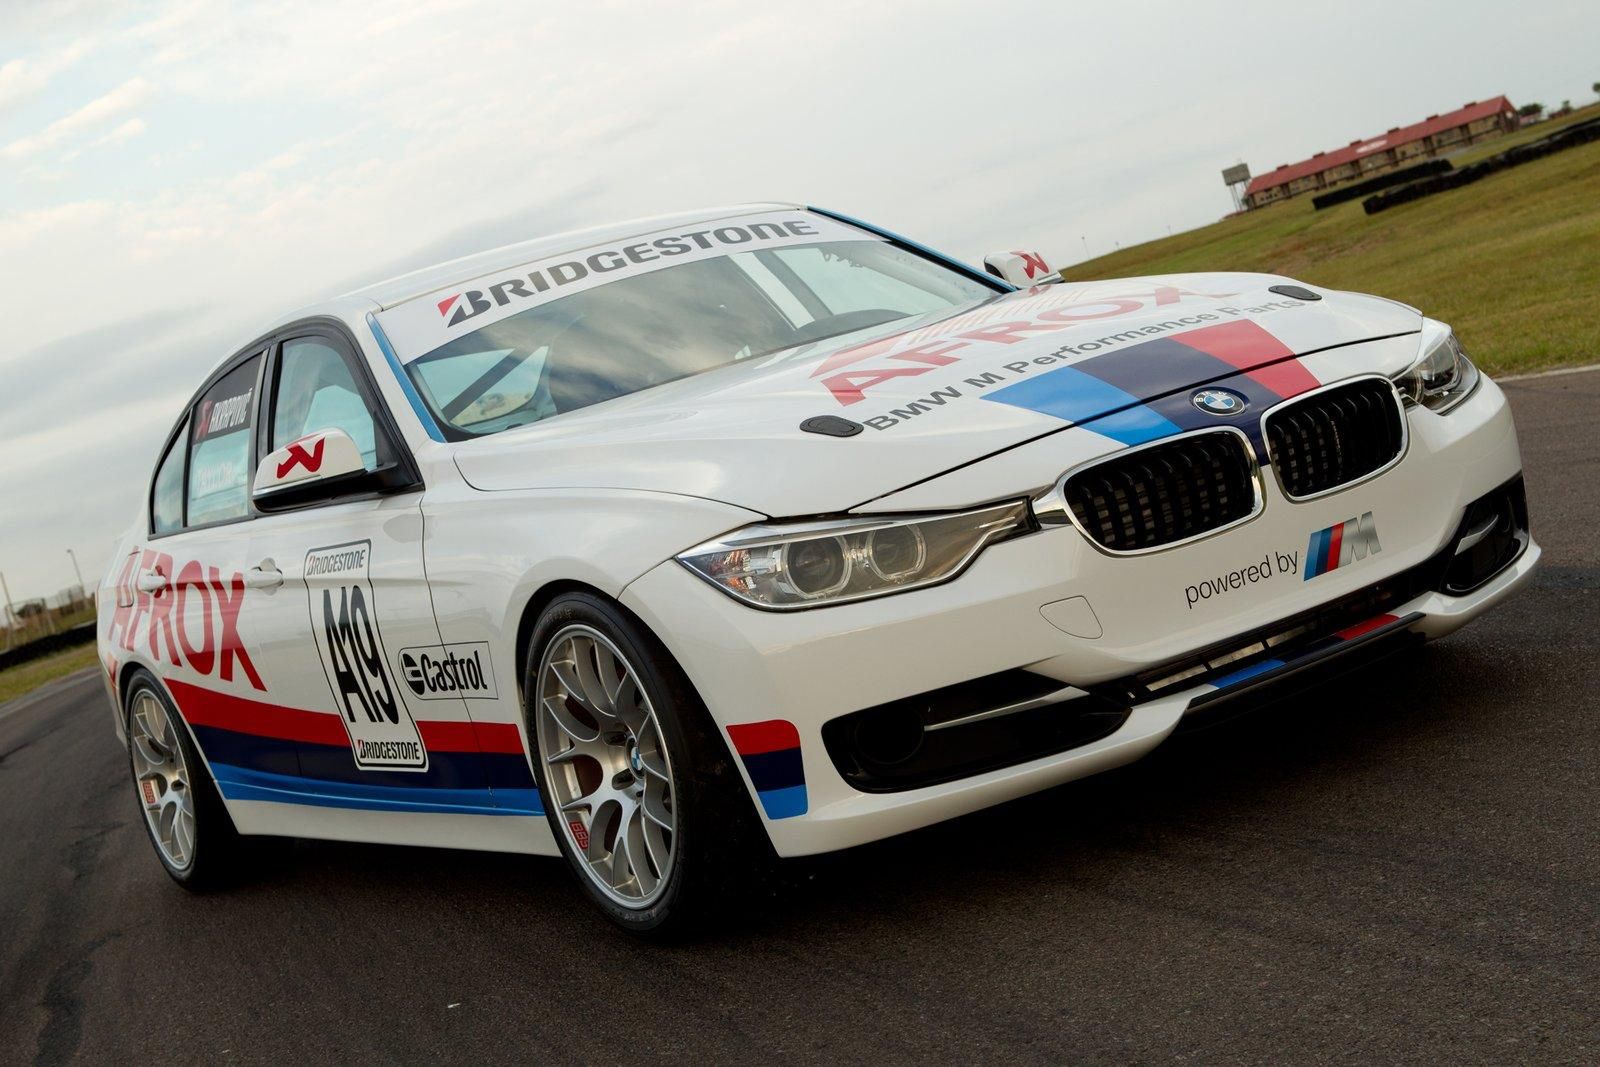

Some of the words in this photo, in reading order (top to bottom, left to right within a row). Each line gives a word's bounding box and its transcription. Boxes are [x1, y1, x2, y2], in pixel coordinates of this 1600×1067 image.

[437, 221, 819, 328] BRIDGESTONE
[821, 285, 1241, 407] AFROX
[863, 385, 963, 431] BMW
[963, 372, 1005, 388] M
[1003, 312, 1219, 374] Performance
[1217, 299, 1307, 317] Parts
[306, 549, 366, 576] BRIDGESTONE
[1185, 557, 1272, 609] powered
[1275, 551, 1299, 576] by
[108, 545, 267, 692] AFROX
[420, 650, 488, 693] Castrol
[357, 739, 420, 760] BRIDGESTONE
